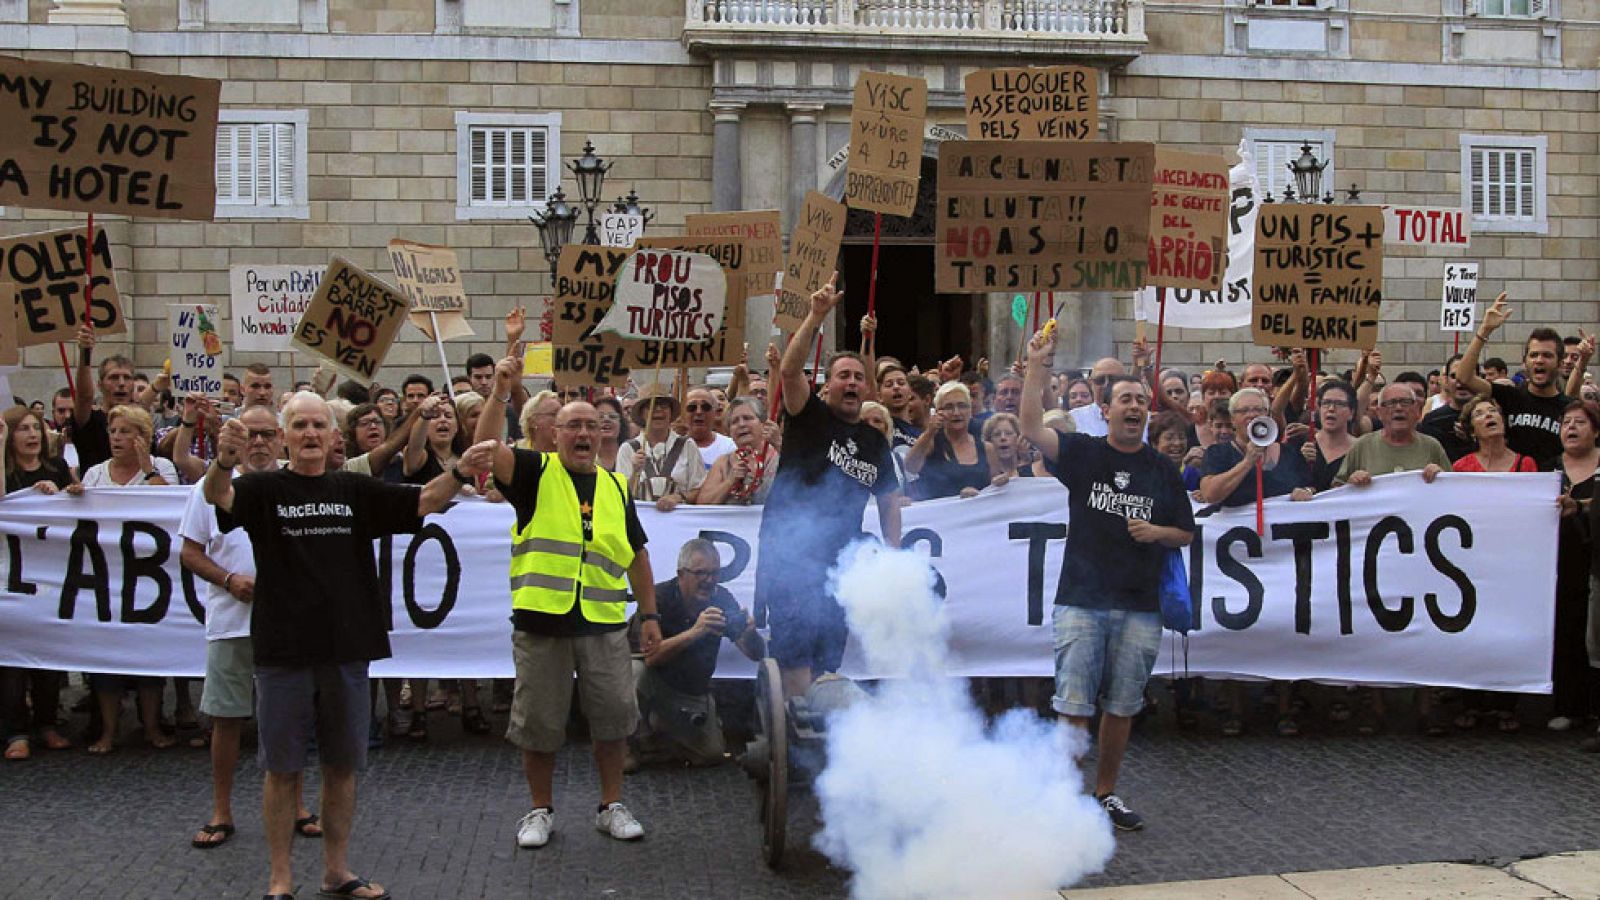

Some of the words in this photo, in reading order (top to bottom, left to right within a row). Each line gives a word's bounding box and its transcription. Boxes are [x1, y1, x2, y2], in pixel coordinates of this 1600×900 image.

[0, 74, 52, 108] MY
[991, 71, 1086, 93] LLOGUER
[970, 94, 1089, 118] ASSEQUIBLE
[31, 115, 77, 152] IS
[98, 123, 190, 160] NOT
[980, 119, 1020, 140] PELS
[0, 158, 28, 196] A
[50, 163, 182, 210] HOTEL
[1181, 195, 1221, 211] GENTE
[1162, 213, 1192, 228] DEL
[1261, 213, 1299, 242] UN
[1310, 213, 1352, 245] PIS
[1394, 208, 1467, 244] TOTAL
[946, 225, 990, 258] NO
[574, 250, 627, 276] MY
[633, 253, 692, 284] PROU
[246, 268, 269, 293] Per
[333, 267, 405, 317] AQUEST
[1259, 282, 1299, 305] UNA
[15, 276, 116, 333] ETS
[560, 301, 586, 324] IS
[652, 283, 703, 313] PISOS
[301, 321, 327, 347] ES
[325, 306, 377, 348] NO
[626, 305, 714, 341] TURISTICS
[1261, 312, 1296, 336] DEL
[335, 340, 378, 378] VEN
[554, 344, 630, 385] HOTEL
[1508, 413, 1561, 435] CARHAR
